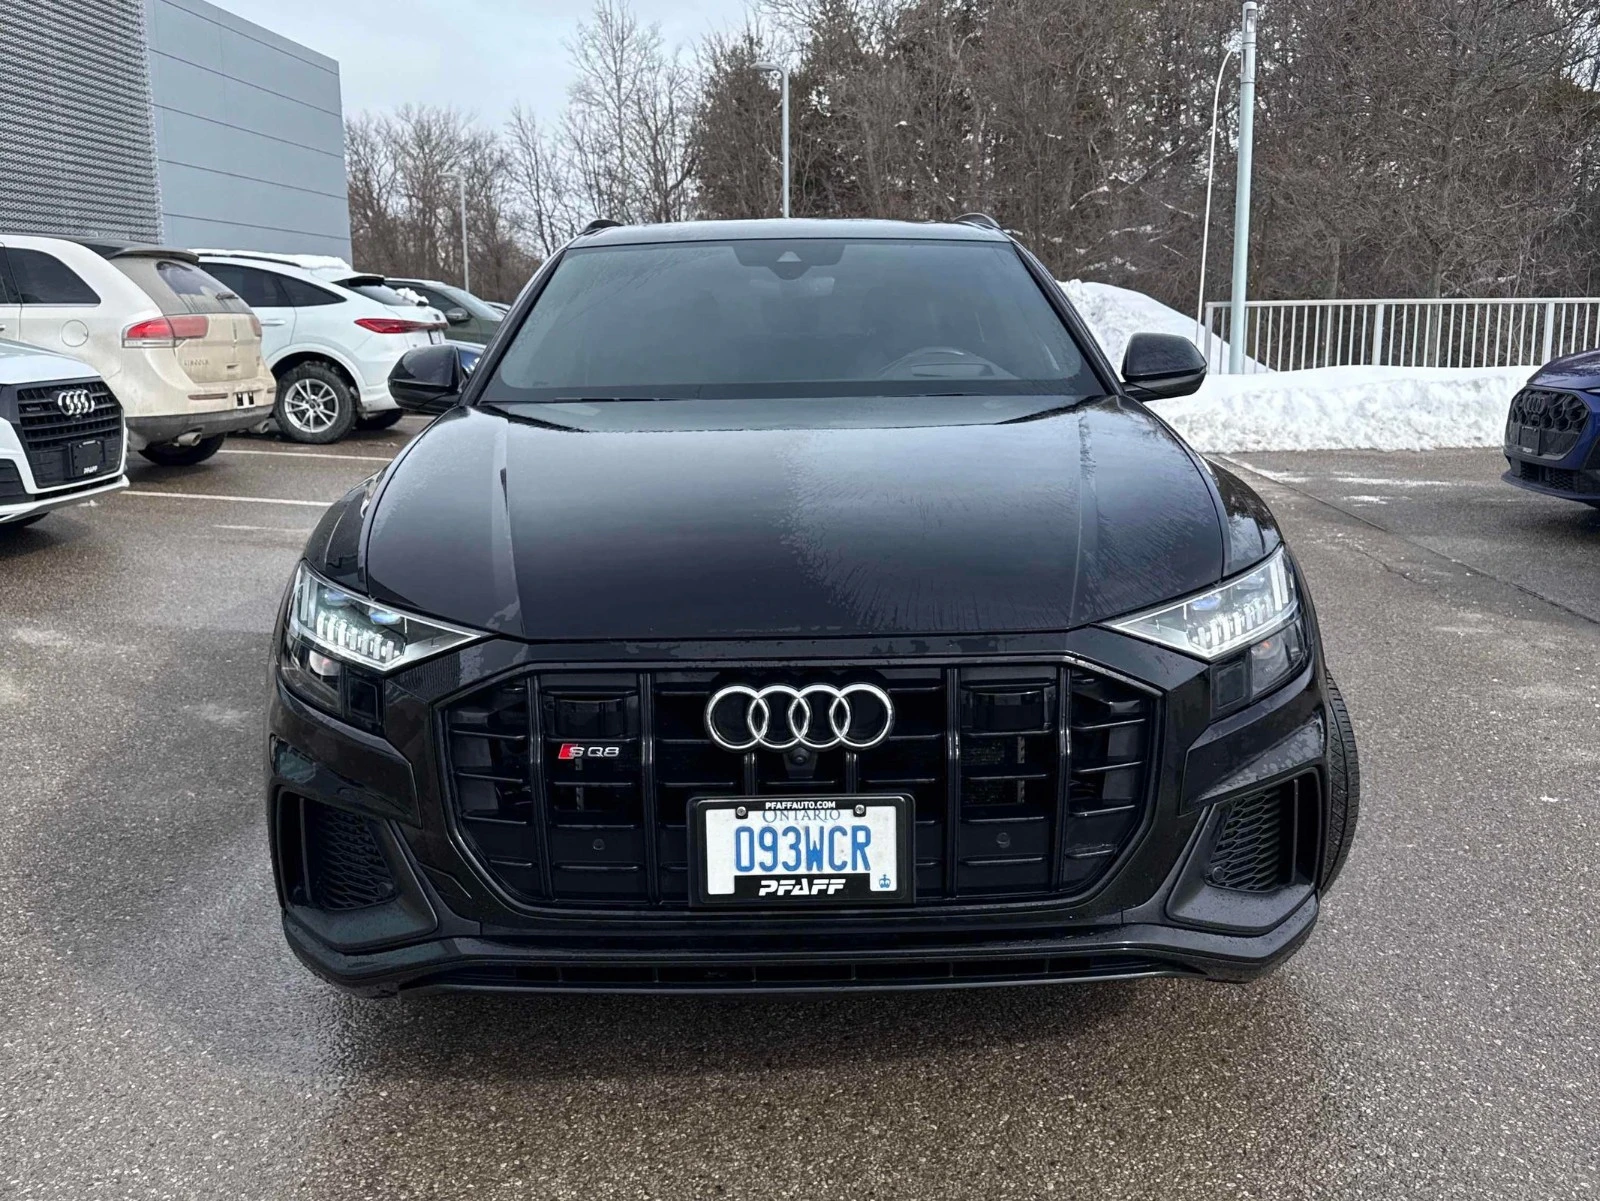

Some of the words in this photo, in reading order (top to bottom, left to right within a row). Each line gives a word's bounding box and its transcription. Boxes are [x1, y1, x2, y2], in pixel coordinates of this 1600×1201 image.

[765, 801, 836, 810] PFAFFAUTO.COM
[762, 809, 841, 823] ONTARIO
[735, 825, 872, 872] 093WCR
[758, 878, 846, 896] PFAFF
